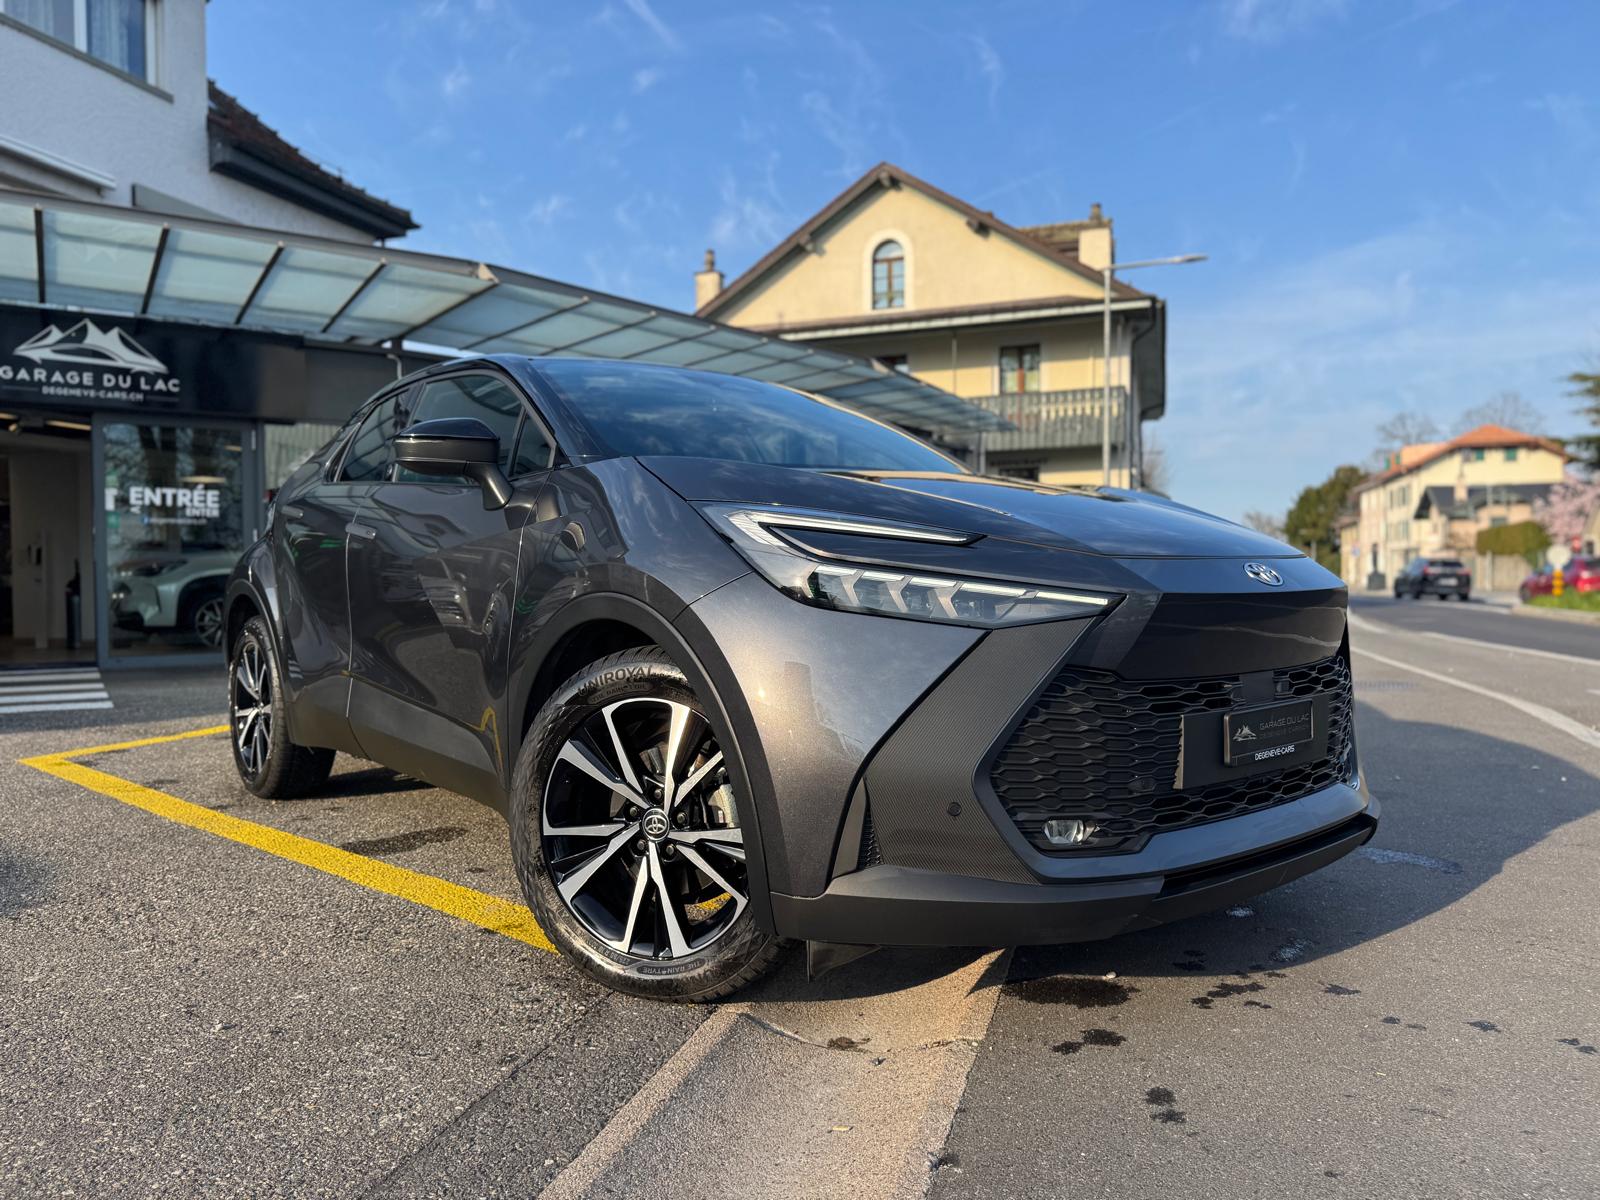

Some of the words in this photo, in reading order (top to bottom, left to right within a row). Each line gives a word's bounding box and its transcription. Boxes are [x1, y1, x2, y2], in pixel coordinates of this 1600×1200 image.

[0, 365, 94, 386] GARAGE
[102, 373, 132, 388] DU
[140, 376, 181, 393] LAC
[129, 484, 220, 508] ENTRÉE
[185, 507, 220, 518] ENTER
[1259, 718, 1286, 730] GARAGE
[1286, 716, 1297, 725] DU
